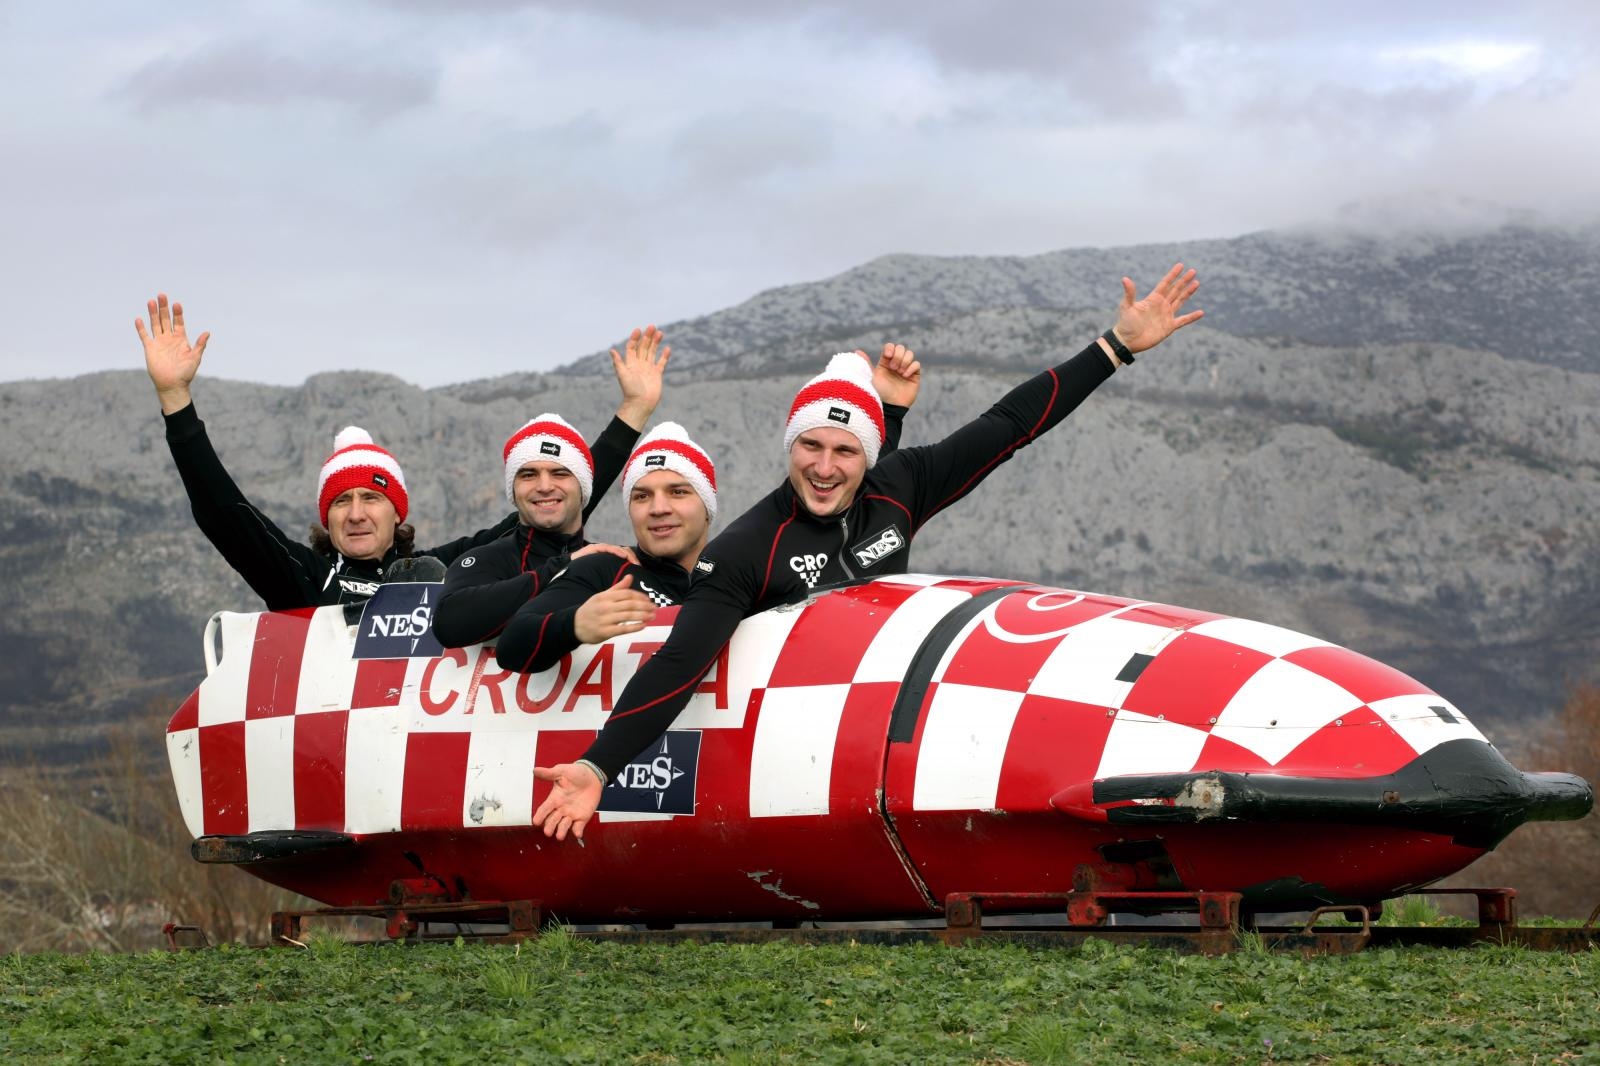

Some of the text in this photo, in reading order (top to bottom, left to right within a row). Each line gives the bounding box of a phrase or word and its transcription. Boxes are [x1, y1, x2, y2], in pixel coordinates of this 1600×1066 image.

[789, 553, 828, 573] CRO
[856, 529, 902, 566] NES
[367, 606, 431, 638] NES
[419, 639, 729, 716] CROATA
